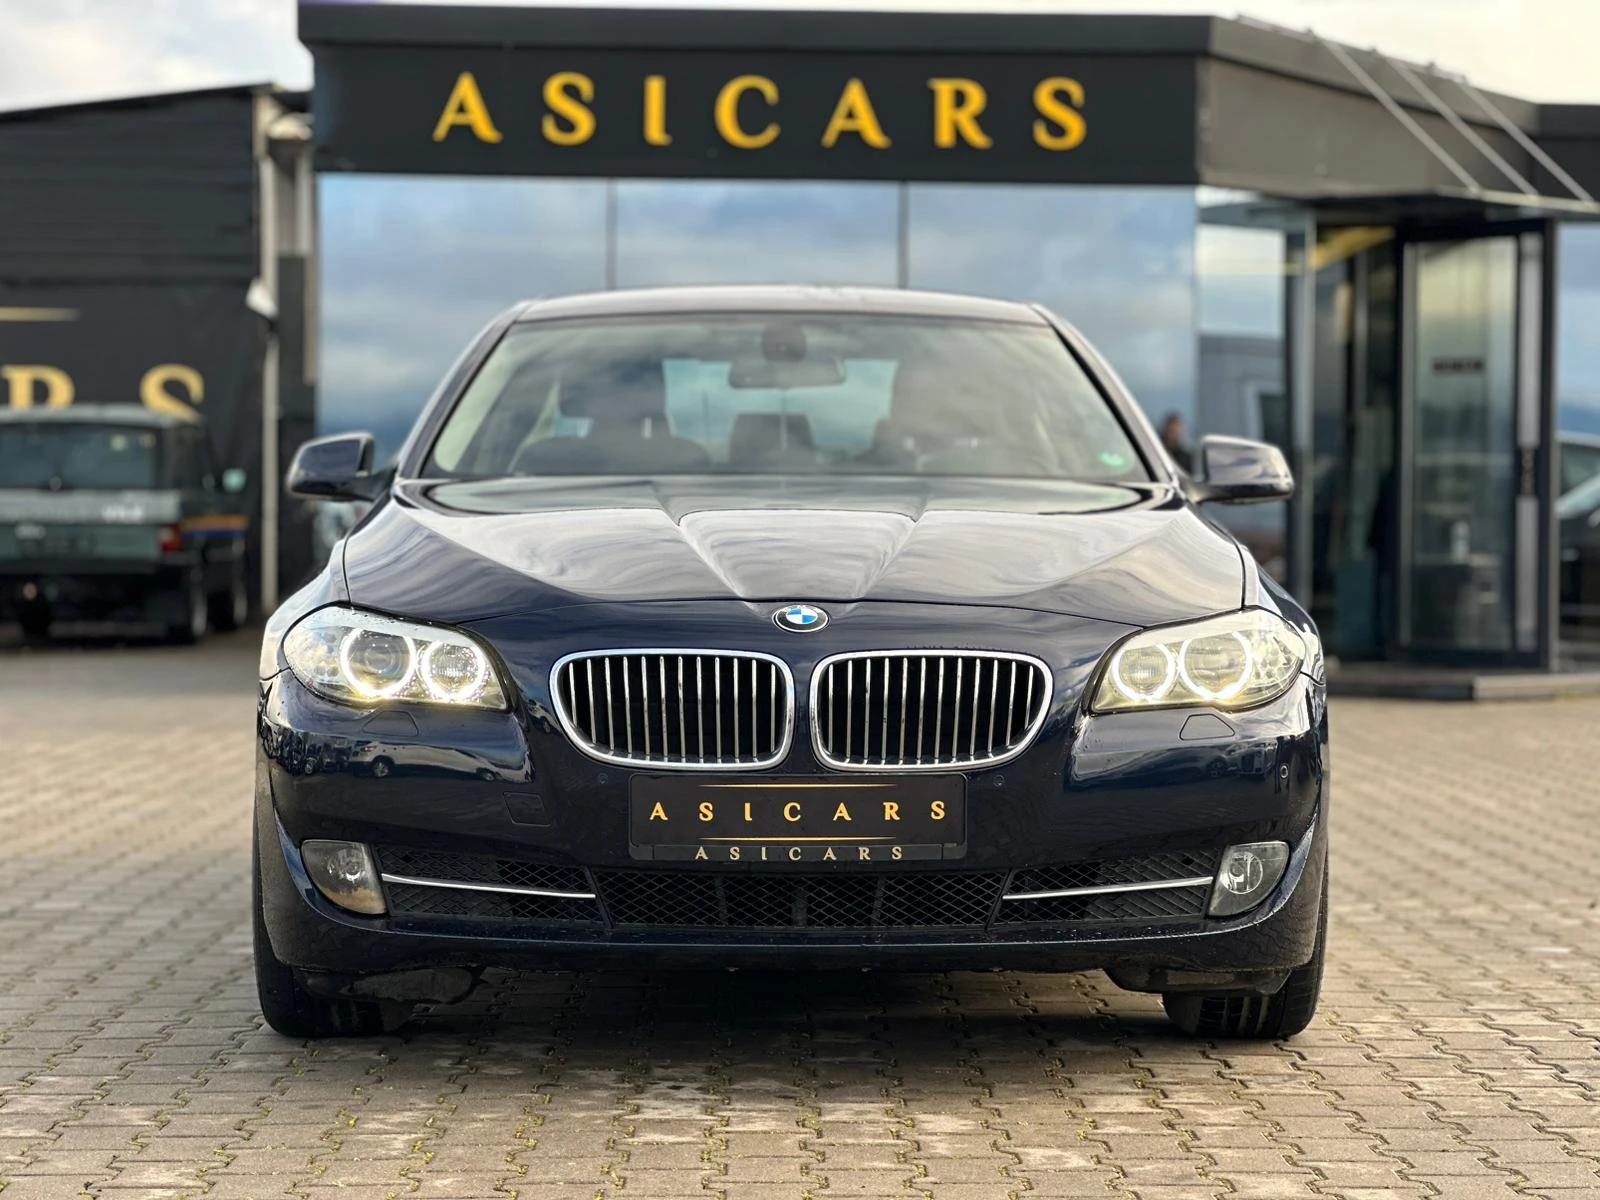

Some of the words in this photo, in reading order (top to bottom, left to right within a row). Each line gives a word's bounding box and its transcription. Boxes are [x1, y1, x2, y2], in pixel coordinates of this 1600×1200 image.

[434, 72, 1087, 150] ASICARS
[650, 801, 946, 822] ASICARS
[695, 846, 903, 861] ASICARS
